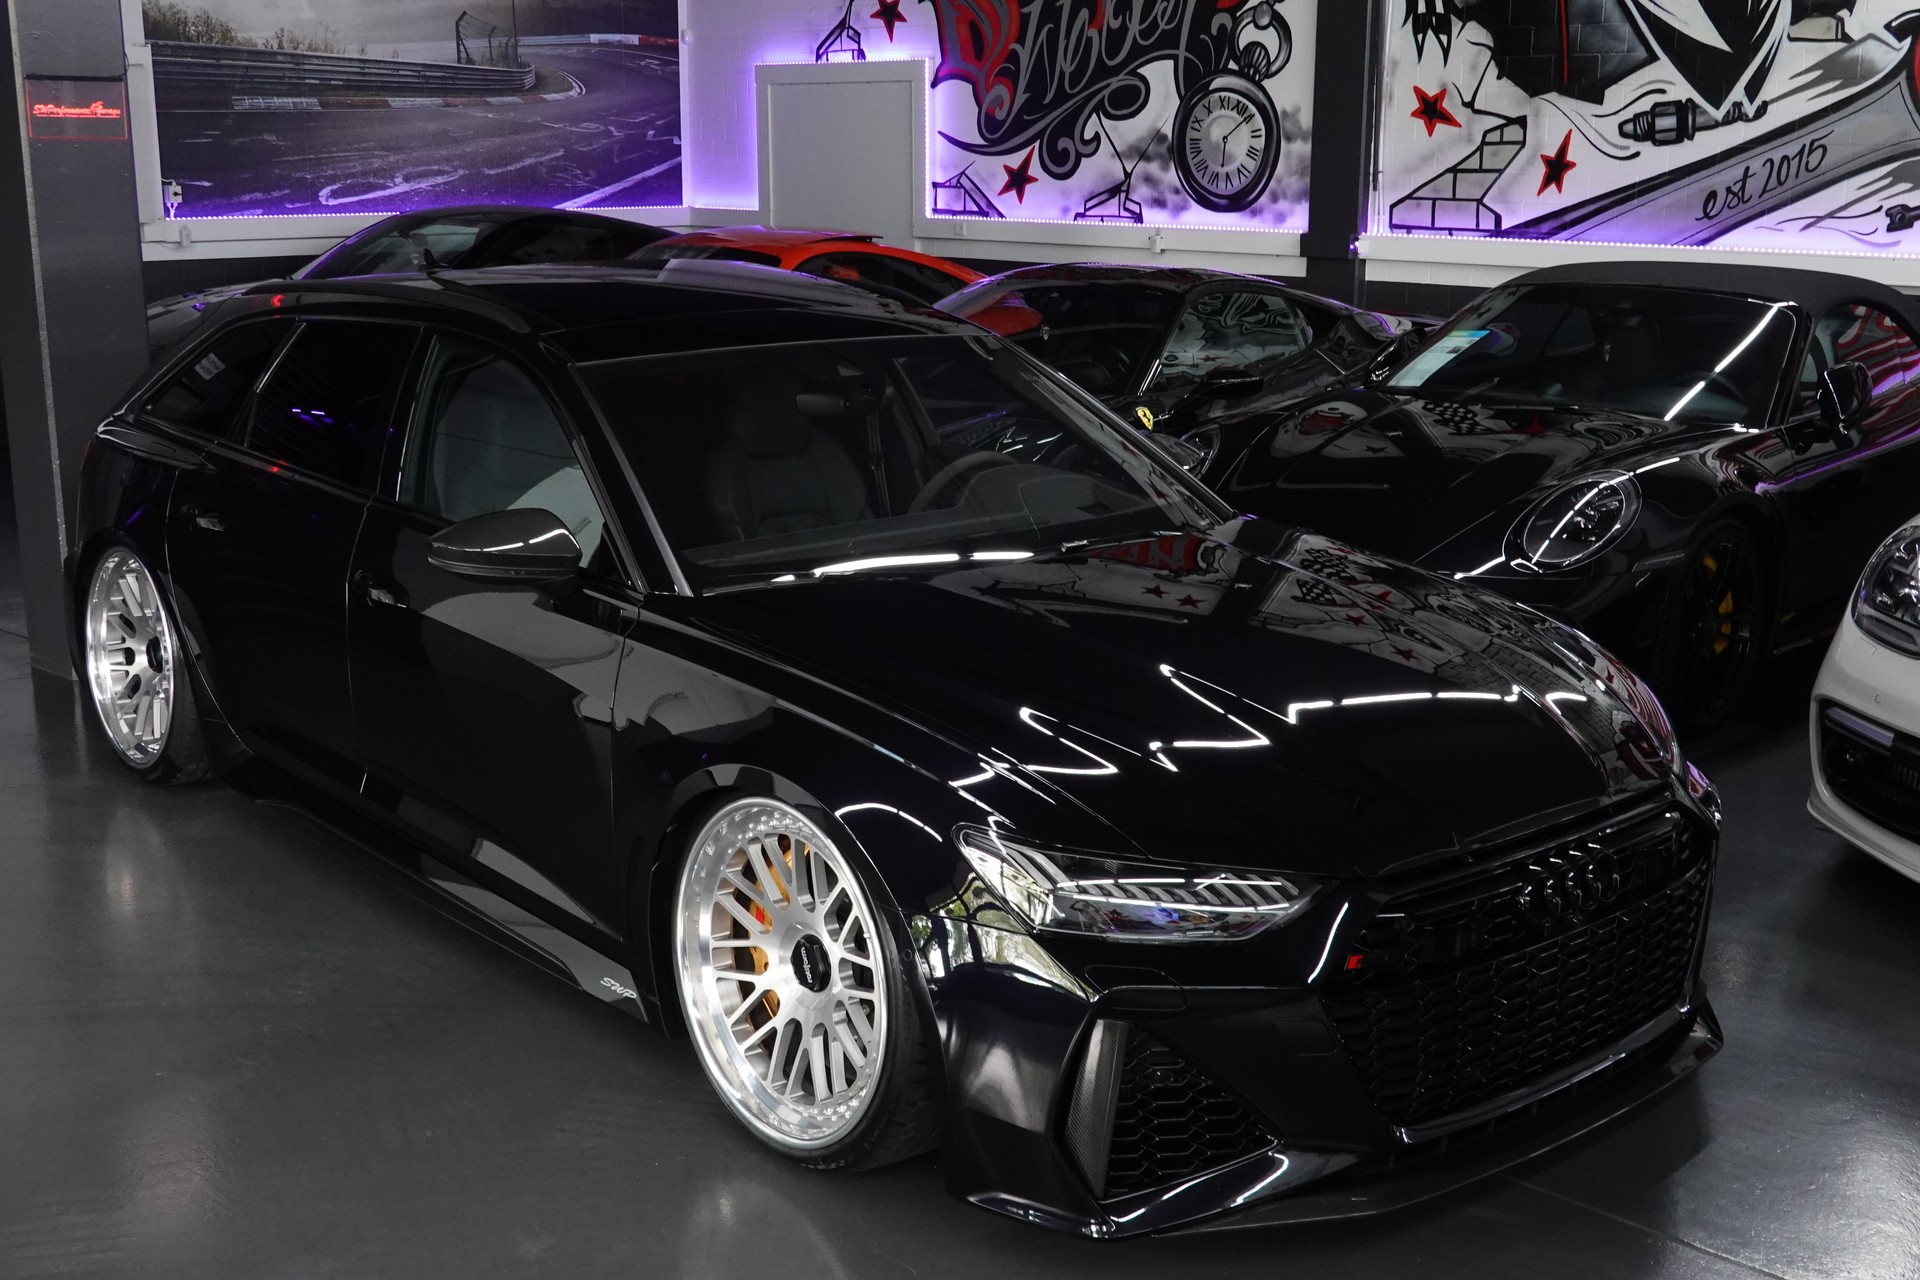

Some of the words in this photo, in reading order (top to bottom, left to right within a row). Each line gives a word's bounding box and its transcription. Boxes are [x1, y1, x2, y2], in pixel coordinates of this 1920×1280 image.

[1202, 98, 1213, 117] X
[1219, 95, 1231, 111] XI
[1230, 99, 1249, 118] XII
[1190, 115, 1204, 132] IX
[1250, 128, 1262, 139] II
[1189, 138, 1203, 161] VIII
[1246, 145, 1260, 162] III
[1225, 171, 1234, 190] V
[1695, 165, 1757, 221] est
[1758, 129, 1835, 199] 2015
[800, 946, 813, 984] rotiform
